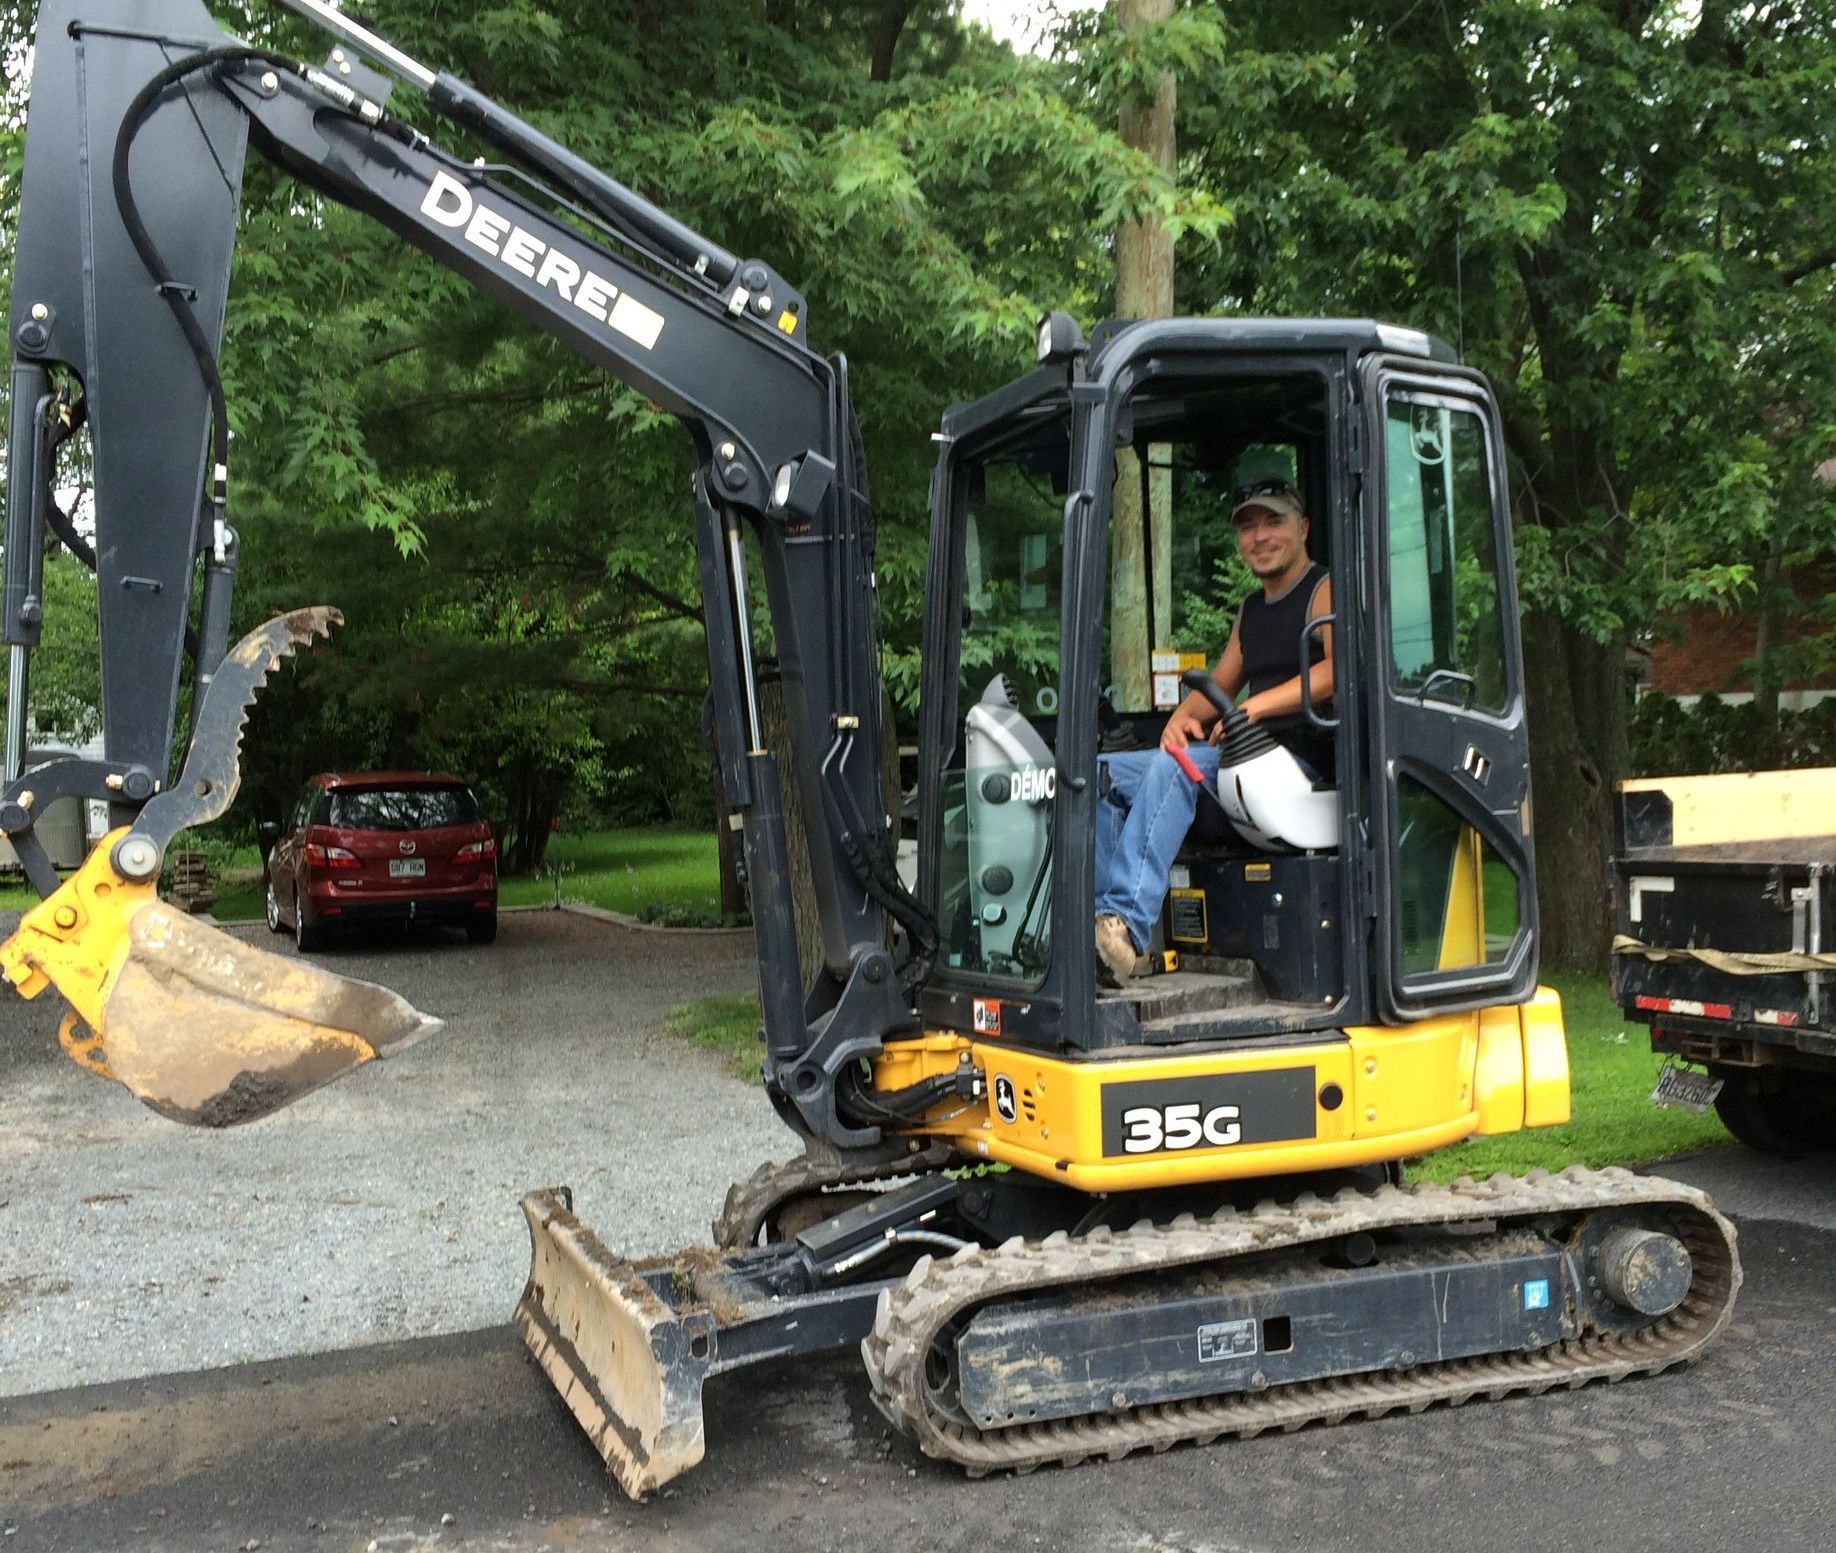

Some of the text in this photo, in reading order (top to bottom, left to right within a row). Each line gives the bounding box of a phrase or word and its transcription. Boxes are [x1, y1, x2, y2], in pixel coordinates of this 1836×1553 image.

[420, 170, 618, 322] DEERE
[1010, 764, 1056, 801] DÉMO
[1122, 1103, 1242, 1153] 35G
